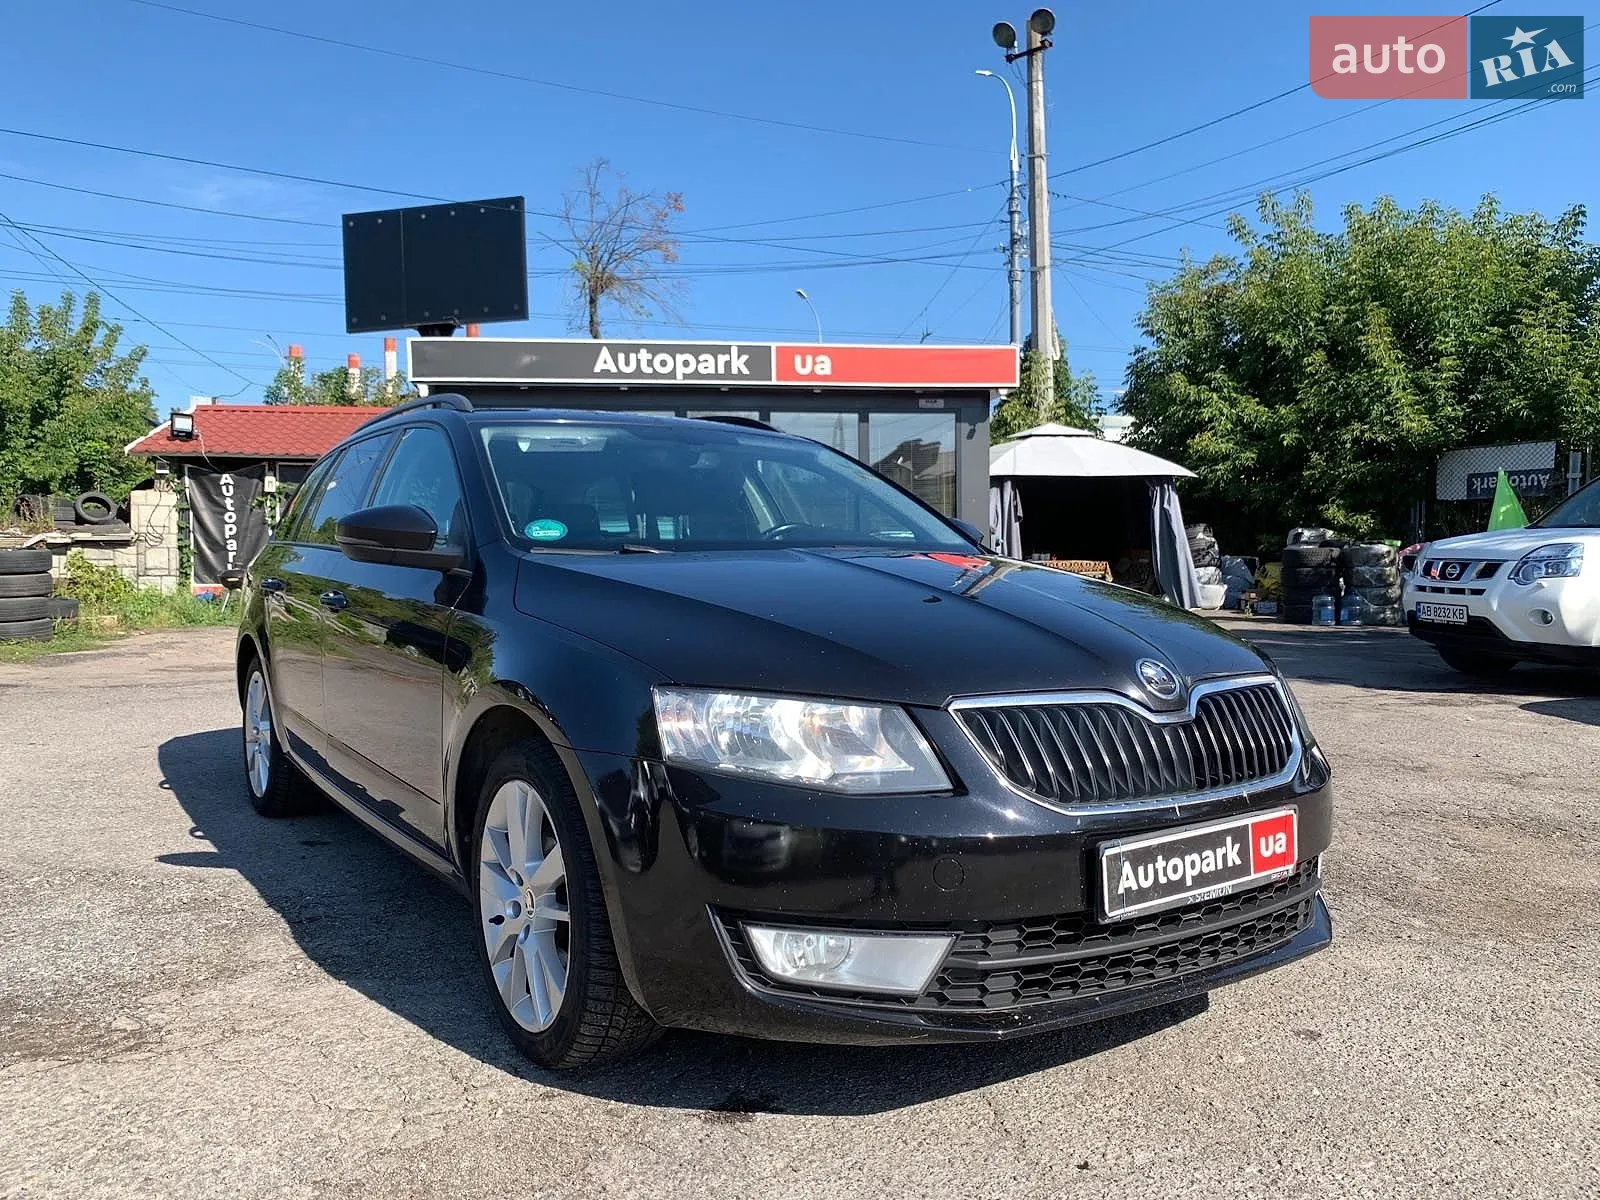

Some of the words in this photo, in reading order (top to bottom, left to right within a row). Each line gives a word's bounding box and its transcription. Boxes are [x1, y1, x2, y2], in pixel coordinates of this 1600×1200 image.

[593, 346, 750, 379] Autopark
[794, 353, 832, 376] ua
[1472, 474, 1550, 494] Autoark
[1421, 605, 1432, 617] AB
[1433, 606, 1451, 618] 8232
[1452, 608, 1465, 620] KB
[1117, 836, 1242, 894] Autopark
[1259, 831, 1287, 858] ua
